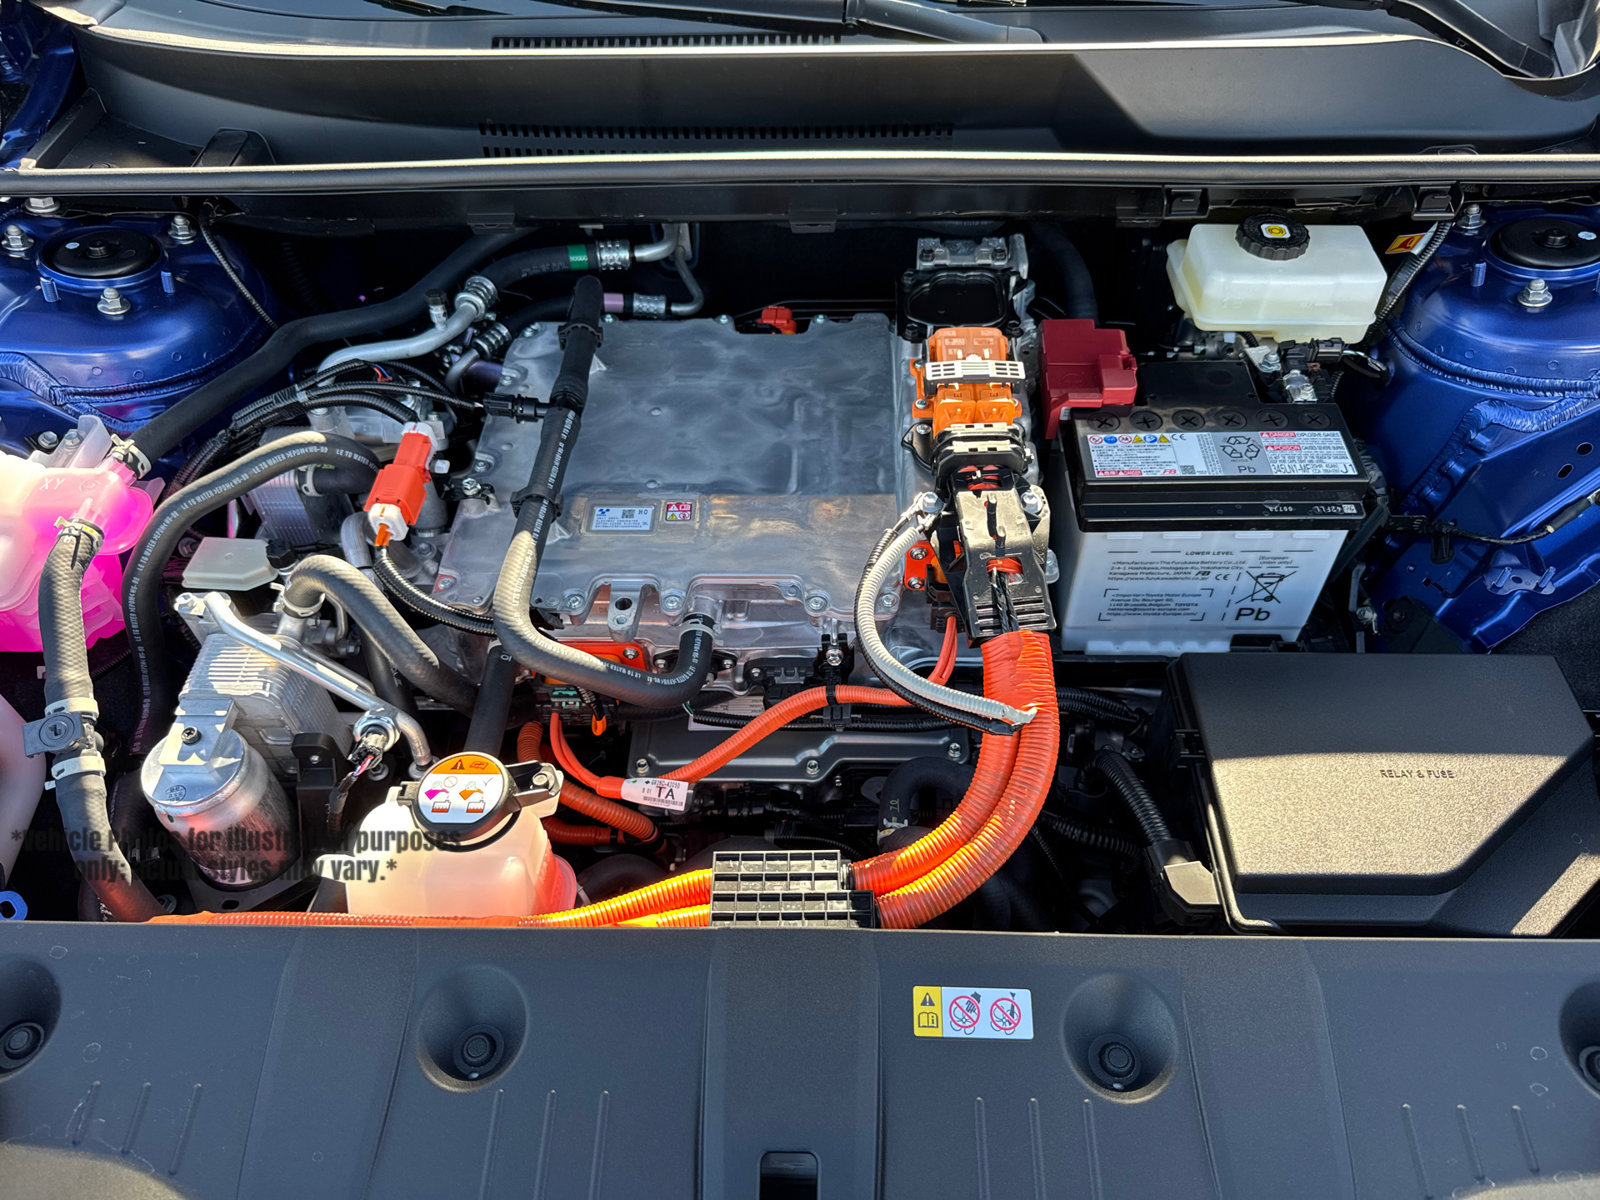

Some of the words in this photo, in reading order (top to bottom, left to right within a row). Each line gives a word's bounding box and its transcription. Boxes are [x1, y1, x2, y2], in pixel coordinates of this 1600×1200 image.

[1234, 607, 1270, 621] Pb
[1380, 770, 1412, 778] RELAY
[1416, 770, 1424, 778] &
[1427, 770, 1455, 778] FUSE
[656, 786, 675, 800] TA
